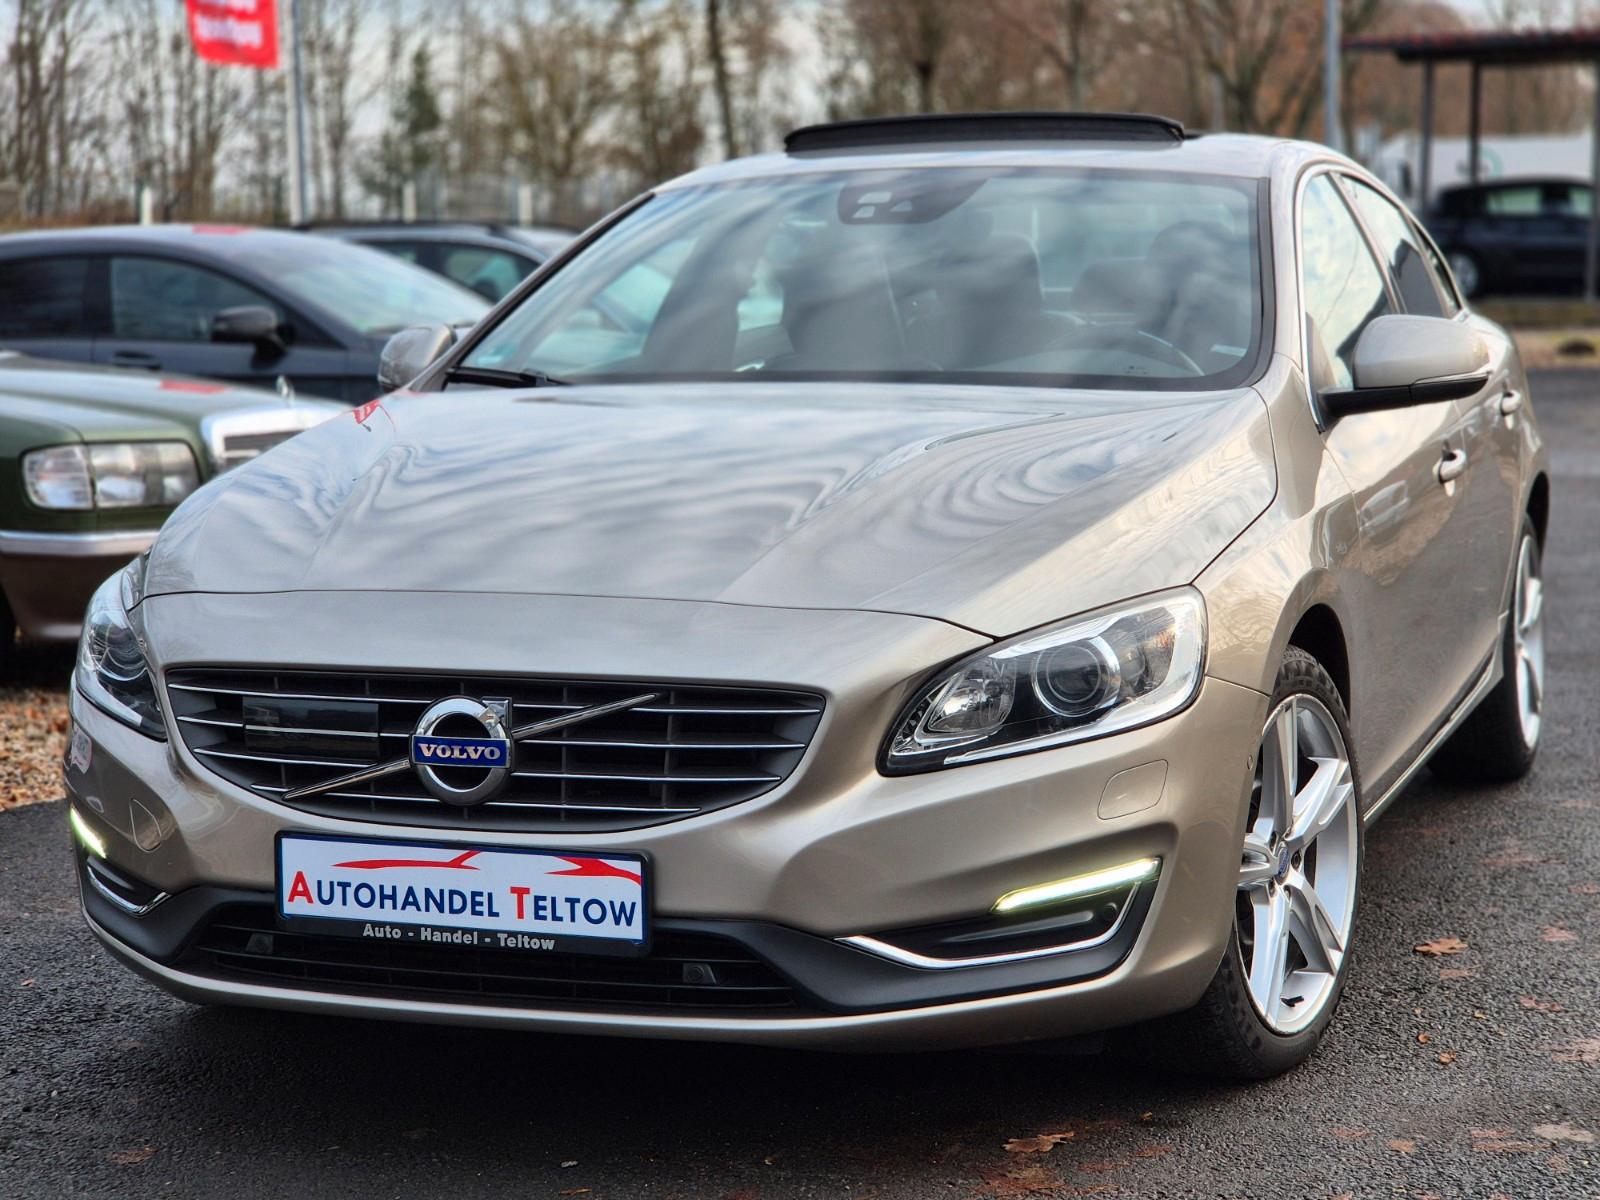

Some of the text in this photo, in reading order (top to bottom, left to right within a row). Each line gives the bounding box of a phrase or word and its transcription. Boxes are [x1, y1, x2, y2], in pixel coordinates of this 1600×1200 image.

[418, 743, 501, 760] VOLVO
[287, 870, 637, 927] AUTOHANDEL TELTOW
[362, 923, 402, 938] Auto
[420, 927, 478, 945] Handel
[497, 933, 556, 950] Teltow
